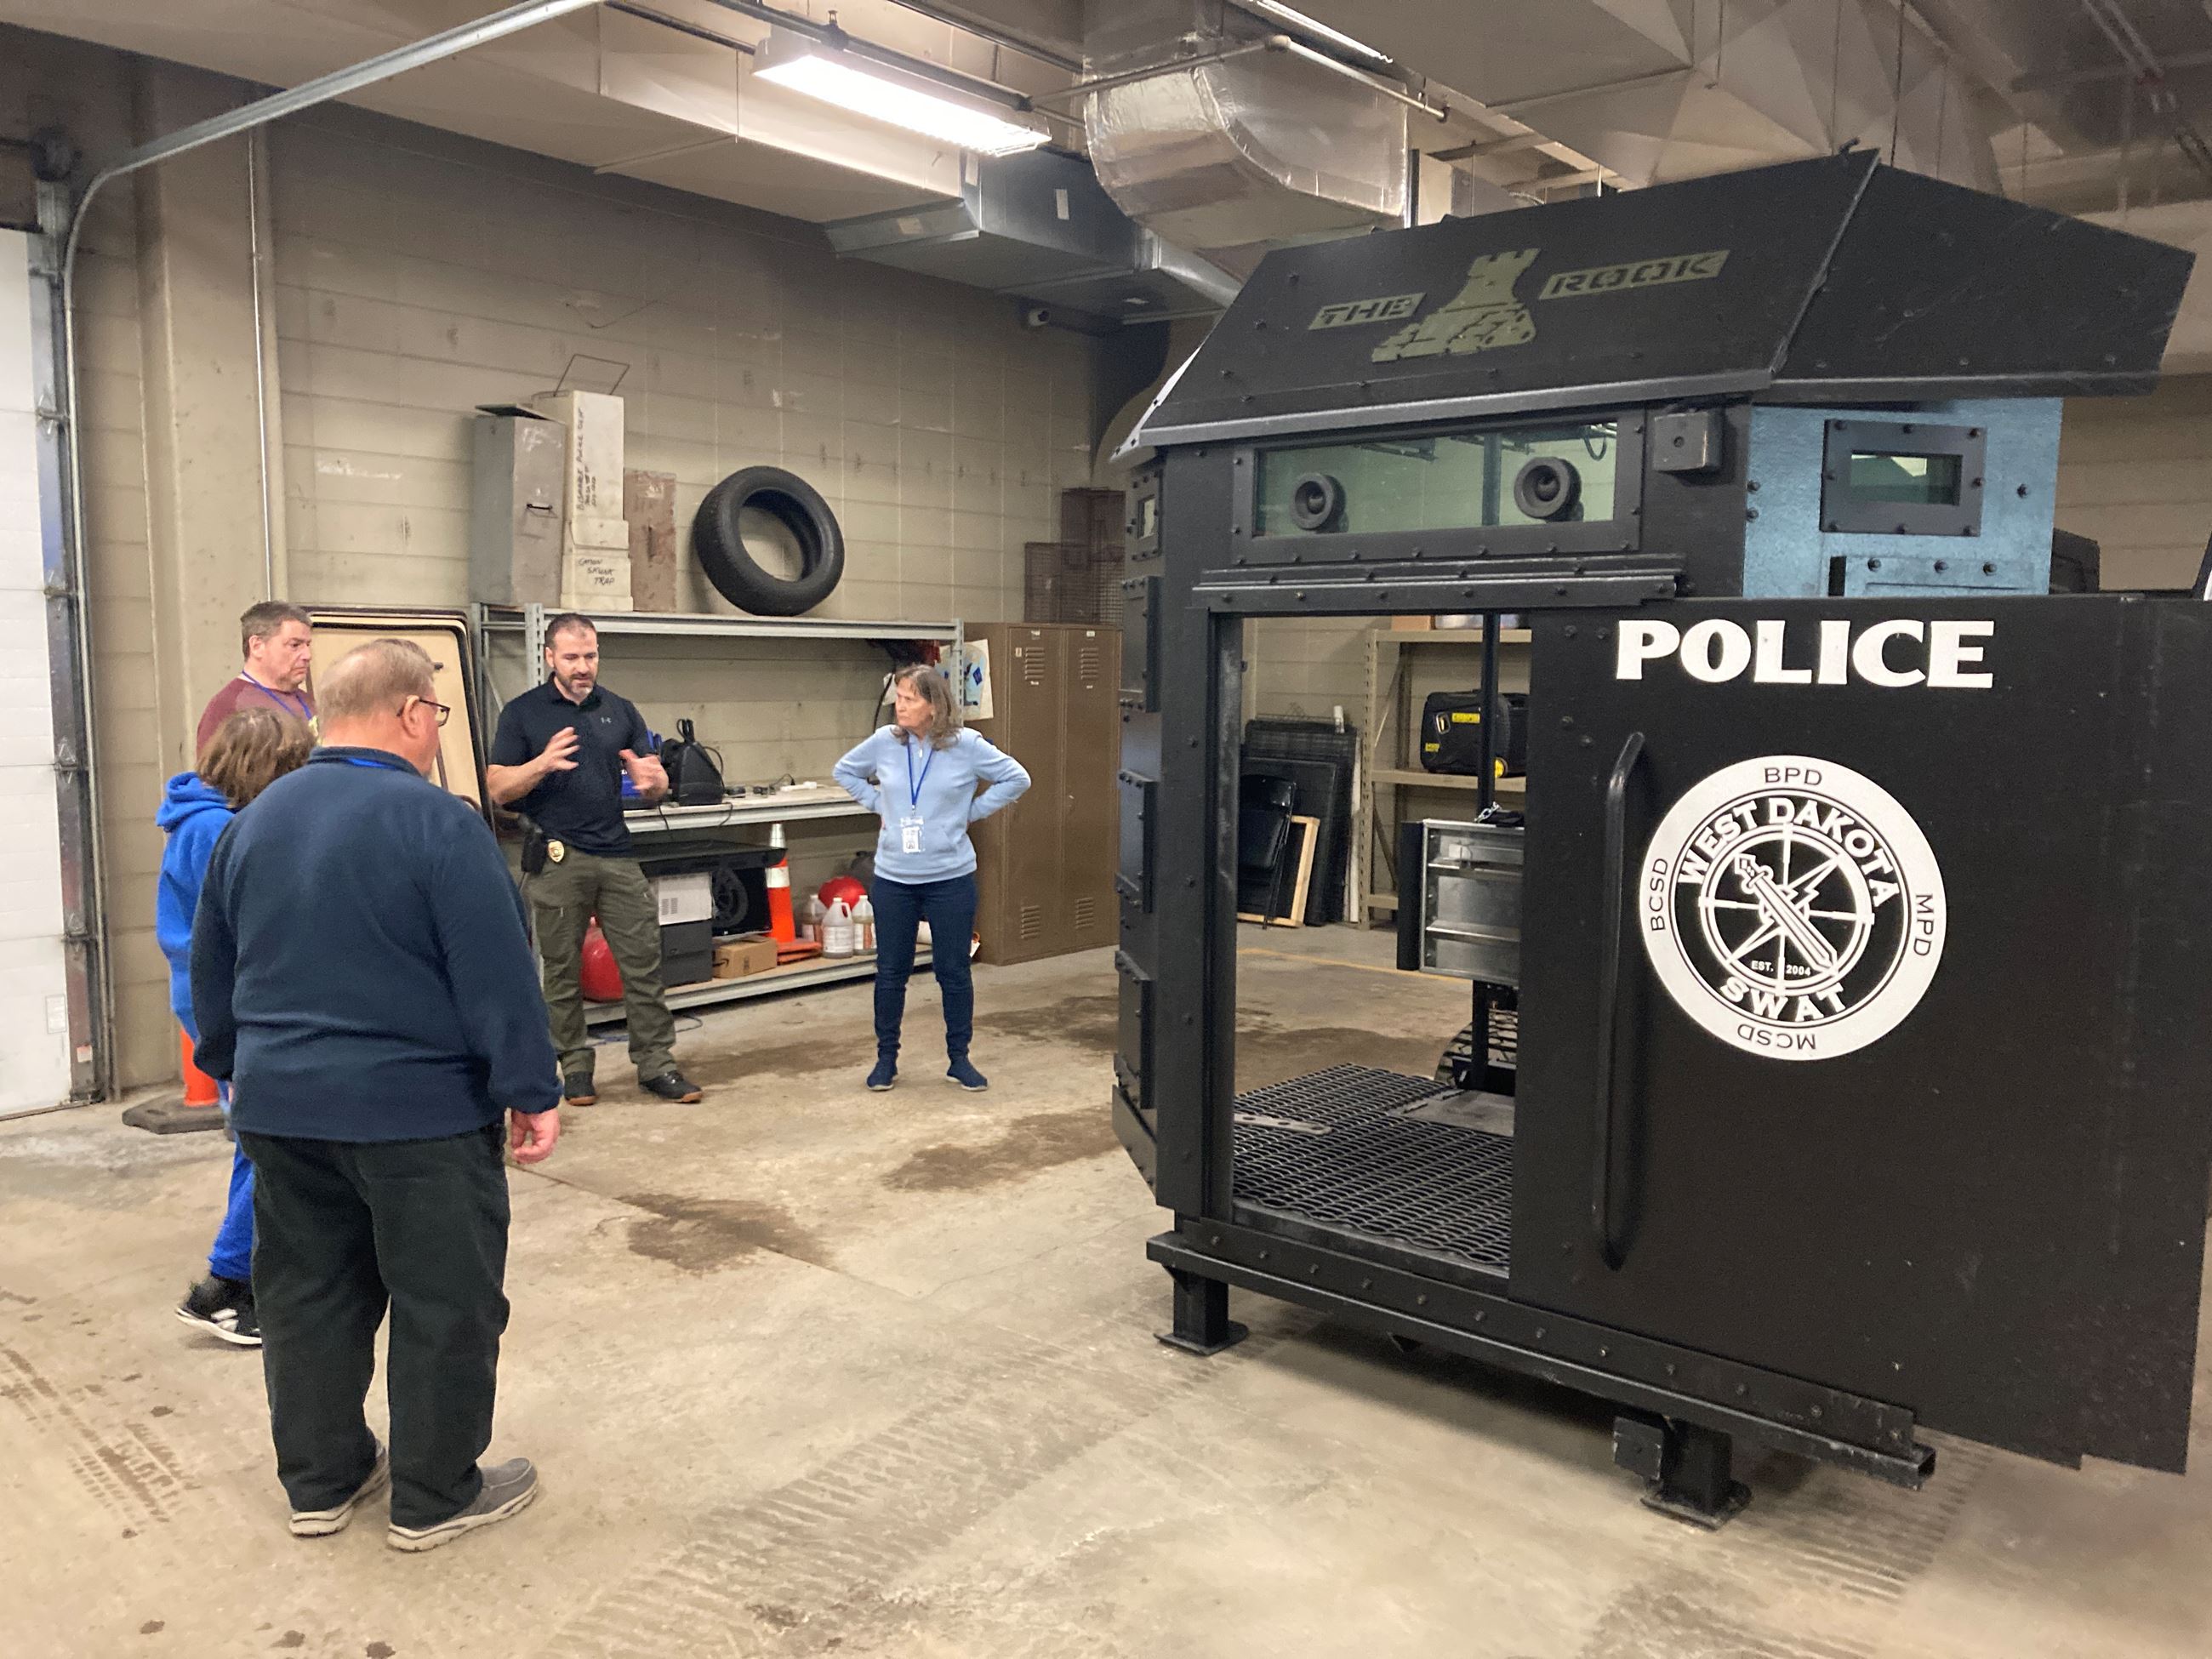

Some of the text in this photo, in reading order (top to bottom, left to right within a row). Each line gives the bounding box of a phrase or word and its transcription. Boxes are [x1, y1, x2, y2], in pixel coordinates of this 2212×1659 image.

[1320, 255, 1714, 325] THE ROOK
[594, 576, 615, 586] TRAP
[1616, 619, 1995, 688] POLICE
[1764, 767, 1823, 787] BPD
[1678, 797, 1902, 908] WEST DAKOTA
[1649, 858, 1669, 932] BCSD
[1913, 893, 1934, 958] MPD
[1751, 960, 1812, 978] EST. 2004
[1719, 976, 1847, 1022] SWAT
[1737, 1023, 1817, 1052] MCSD
